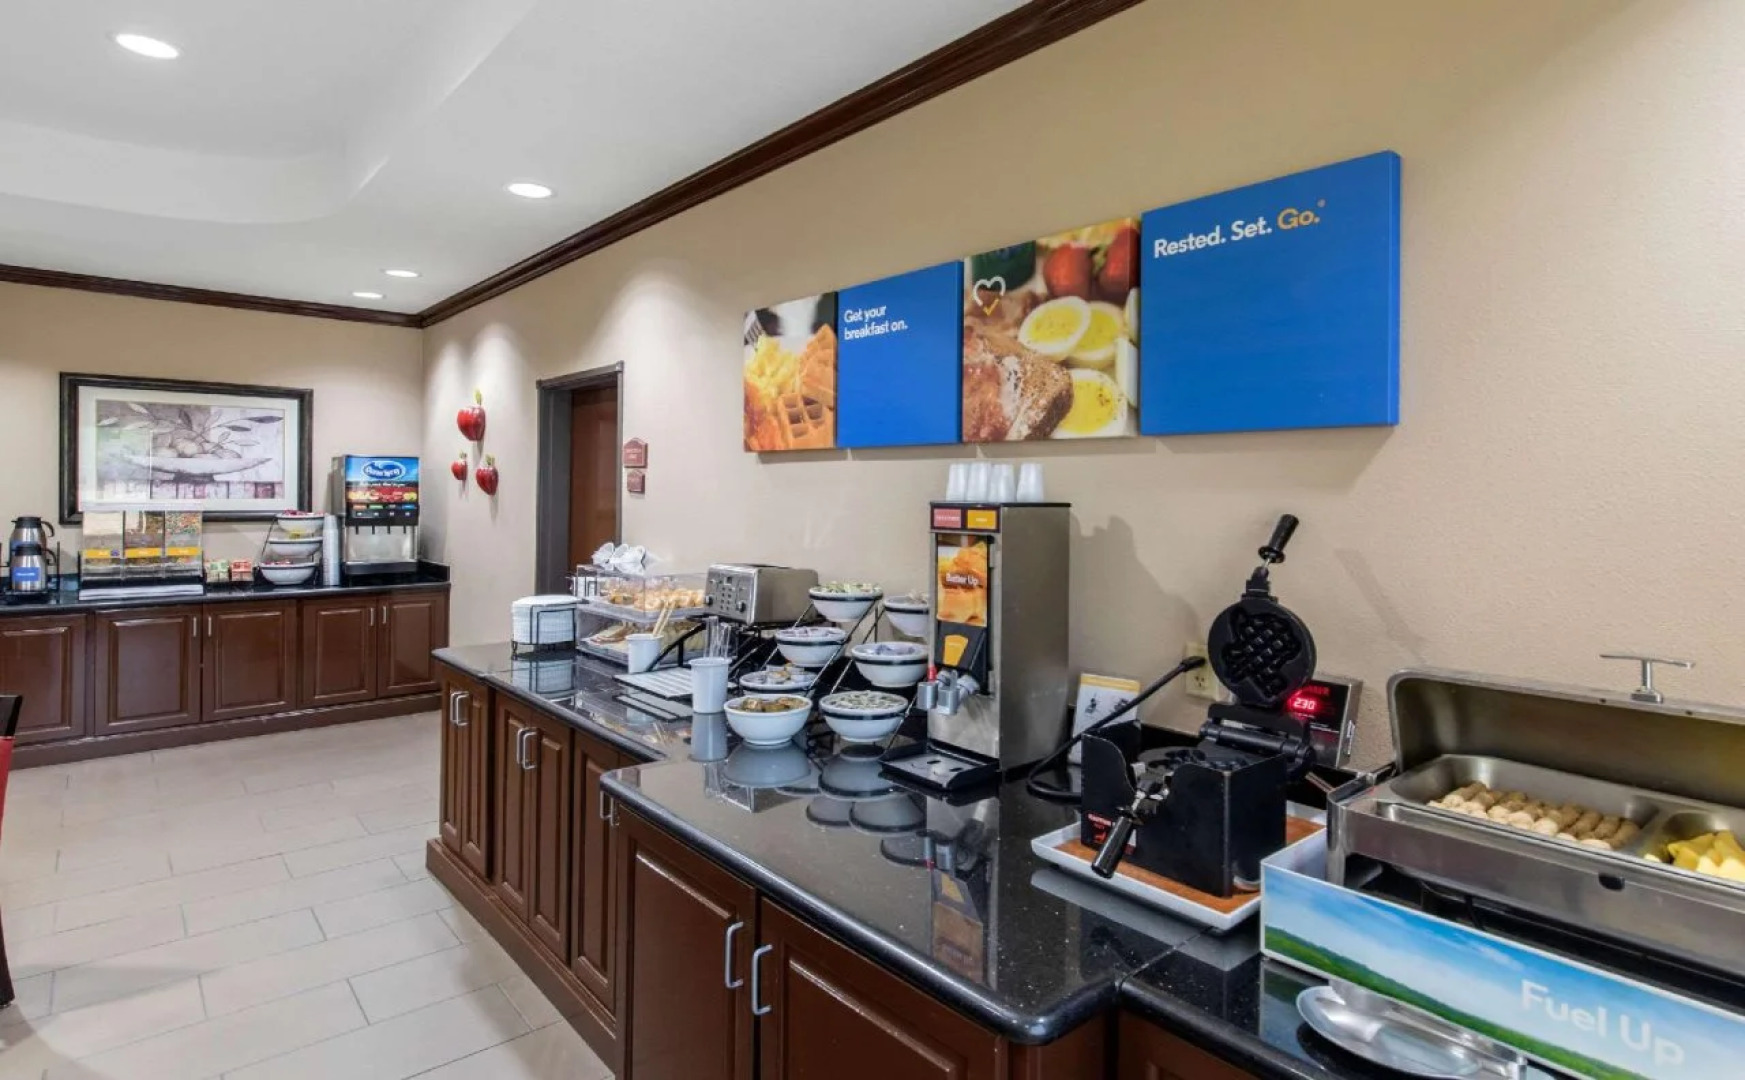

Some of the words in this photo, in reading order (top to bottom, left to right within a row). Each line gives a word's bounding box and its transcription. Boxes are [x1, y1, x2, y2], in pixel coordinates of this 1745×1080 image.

[1154, 225, 1227, 259] Rested.
[1231, 216, 1273, 241] Set.
[844, 307, 863, 323] Get
[863, 305, 887, 323] your
[844, 320, 889, 340] breakfast
[891, 320, 908, 331] on.
[1293, 697, 1316, 710] 230
[1521, 979, 1608, 1038] Fuel
[1620, 1014, 1685, 1066] Up
